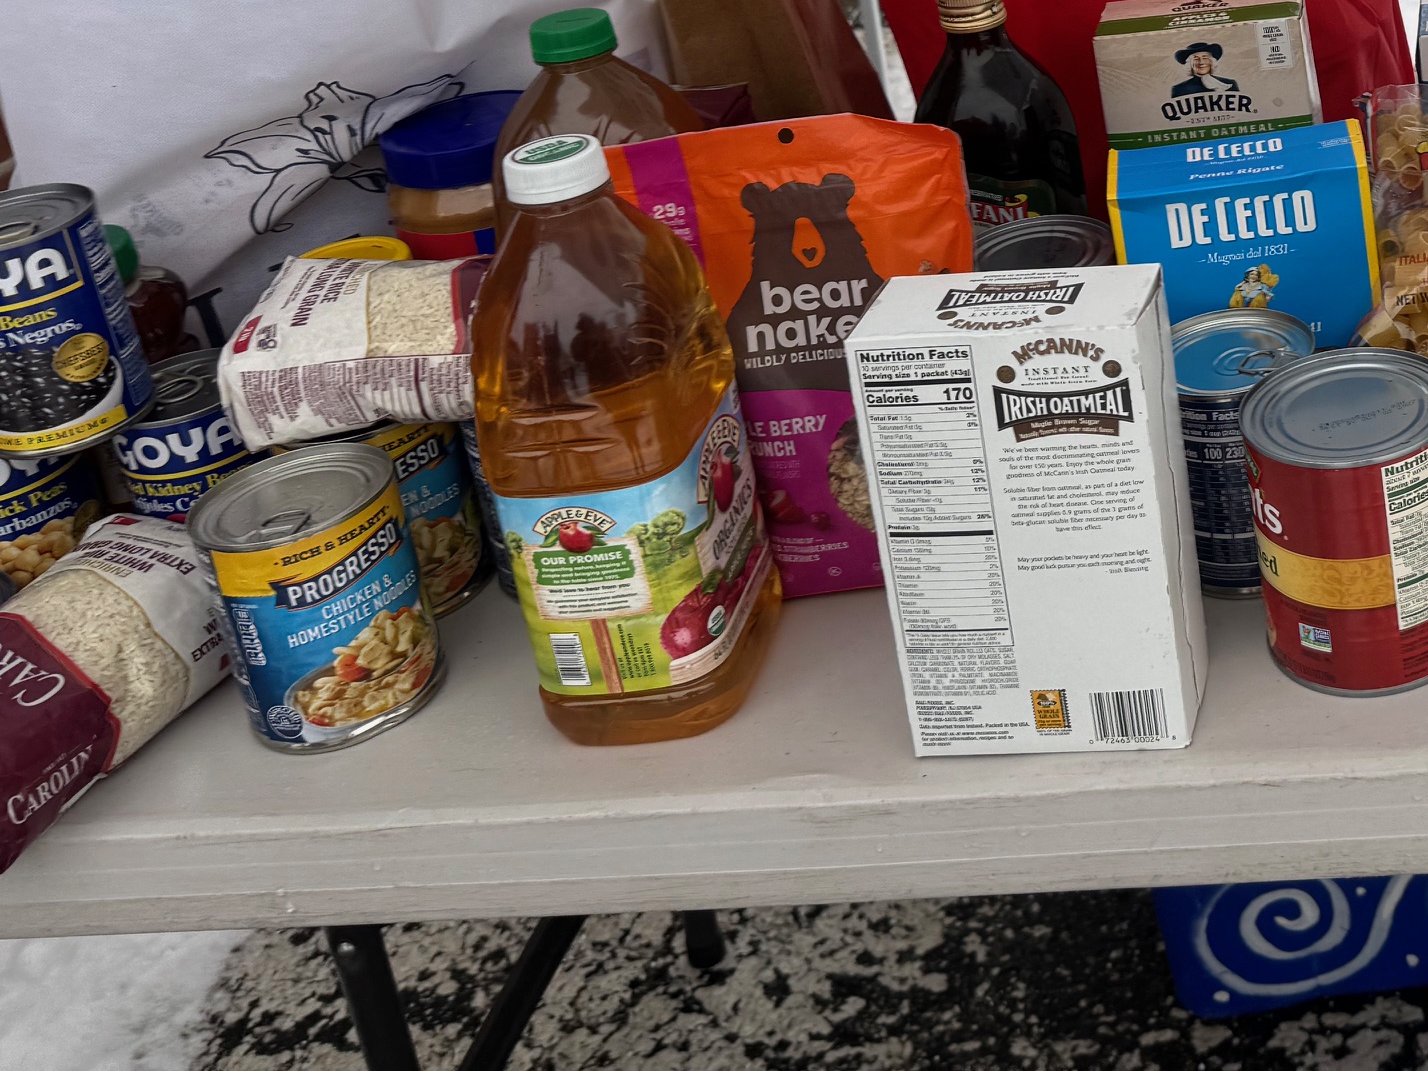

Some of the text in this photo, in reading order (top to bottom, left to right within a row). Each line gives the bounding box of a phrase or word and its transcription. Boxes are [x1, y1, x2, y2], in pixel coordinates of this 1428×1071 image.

[1171, 2, 1229, 13] QUAKER
[1161, 94, 1252, 121] QUAKER
[1148, 123, 1276, 143] INSTANT OATMEAL
[525, 140, 568, 154] USDA
[1186, 138, 1283, 162] DE CECCO
[1189, 163, 1285, 180] Penne Rigate
[1165, 189, 1318, 250] DE CECCO
[1264, 243, 1289, 256] 1831
[0, 248, 70, 297] YA
[319, 281, 346, 304] RICE
[760, 279, 868, 315] bear
[944, 286, 1076, 306] IRISH OATMEAL
[1396, 293, 1418, 307] NET
[0, 308, 57, 330] Beans
[290, 294, 320, 327] GRAIN
[969, 309, 1037, 317] INSTANT
[6, 319, 76, 347] Negros
[745, 314, 859, 353] nake
[744, 354, 786, 369] WILDLY
[860, 348, 969, 363] Nutrition Facts
[1011, 337, 1106, 365] McCANN'S
[862, 372, 893, 380] Serving
[921, 369, 949, 378] packet
[870, 364, 900, 372] servings
[1024, 366, 1091, 376] INSTANT
[866, 387, 973, 404] Calories 170
[1001, 386, 1129, 423] IRISH OATMEAL
[769, 414, 827, 438] BERRY
[1212, 411, 1239, 421] Facts
[112, 416, 242, 471] GOYA
[1203, 447, 1223, 460] 100
[28, 481, 67, 507] Peas
[145, 480, 202, 497] Kidney
[410, 483, 461, 516] NOODLES
[281, 508, 388, 567] RICH & HEARTY
[104, 550, 155, 573] WHITE
[109, 541, 197, 575] EXTRA LONG
[287, 522, 398, 607] PROGRESSO
[540, 551, 624, 565] OUR PROMISE
[321, 574, 393, 620] CHICKEN &
[287, 570, 417, 649] HOMESTYLE NOODLES
[7, 744, 93, 825] CAROLIN
